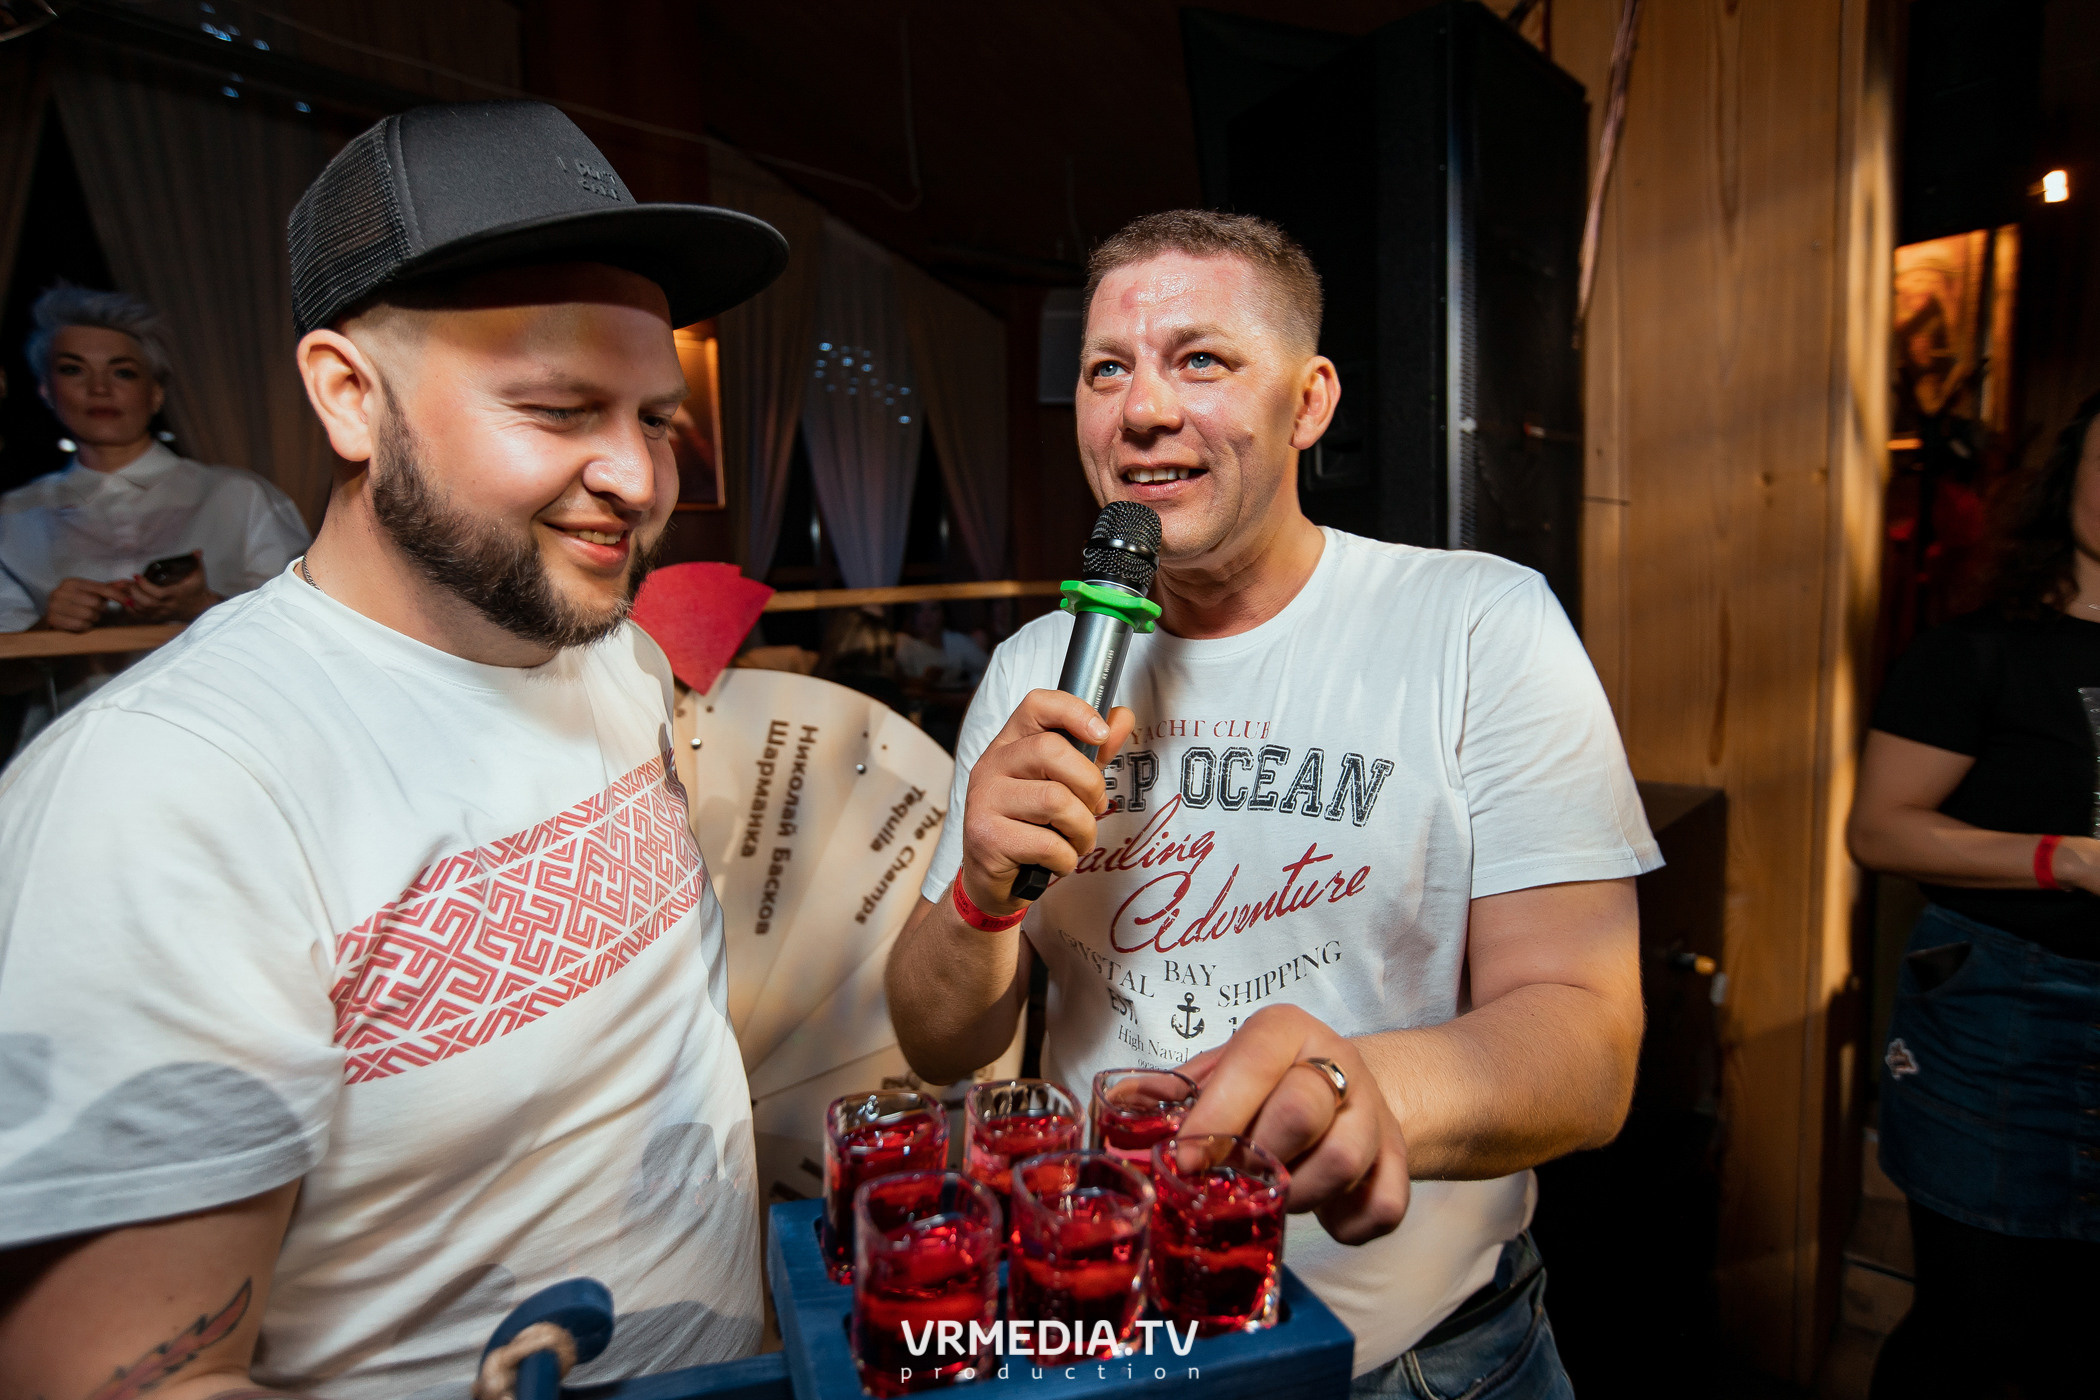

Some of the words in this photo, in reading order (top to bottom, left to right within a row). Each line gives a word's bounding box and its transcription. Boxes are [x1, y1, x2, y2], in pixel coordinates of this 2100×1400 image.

[1131, 719, 1205, 745] YACHT
[1213, 720, 1271, 740] CLUB
[740, 719, 790, 858] Шарманка
[776, 724, 819, 837] Николай
[1103, 750, 1160, 813] EP
[1179, 744, 1395, 828] OCEAN
[914, 805, 946, 841] The
[1048, 793, 1216, 886] ailing
[755, 848, 792, 936] Басков
[854, 845, 915, 925] Champs
[1110, 842, 1372, 954] Adventure
[1164, 960, 1217, 987] BAY
[1218, 940, 1342, 1008] SHIPPING
[1118, 1025, 1144, 1052] High
[1148, 1039, 1189, 1064] Naval
